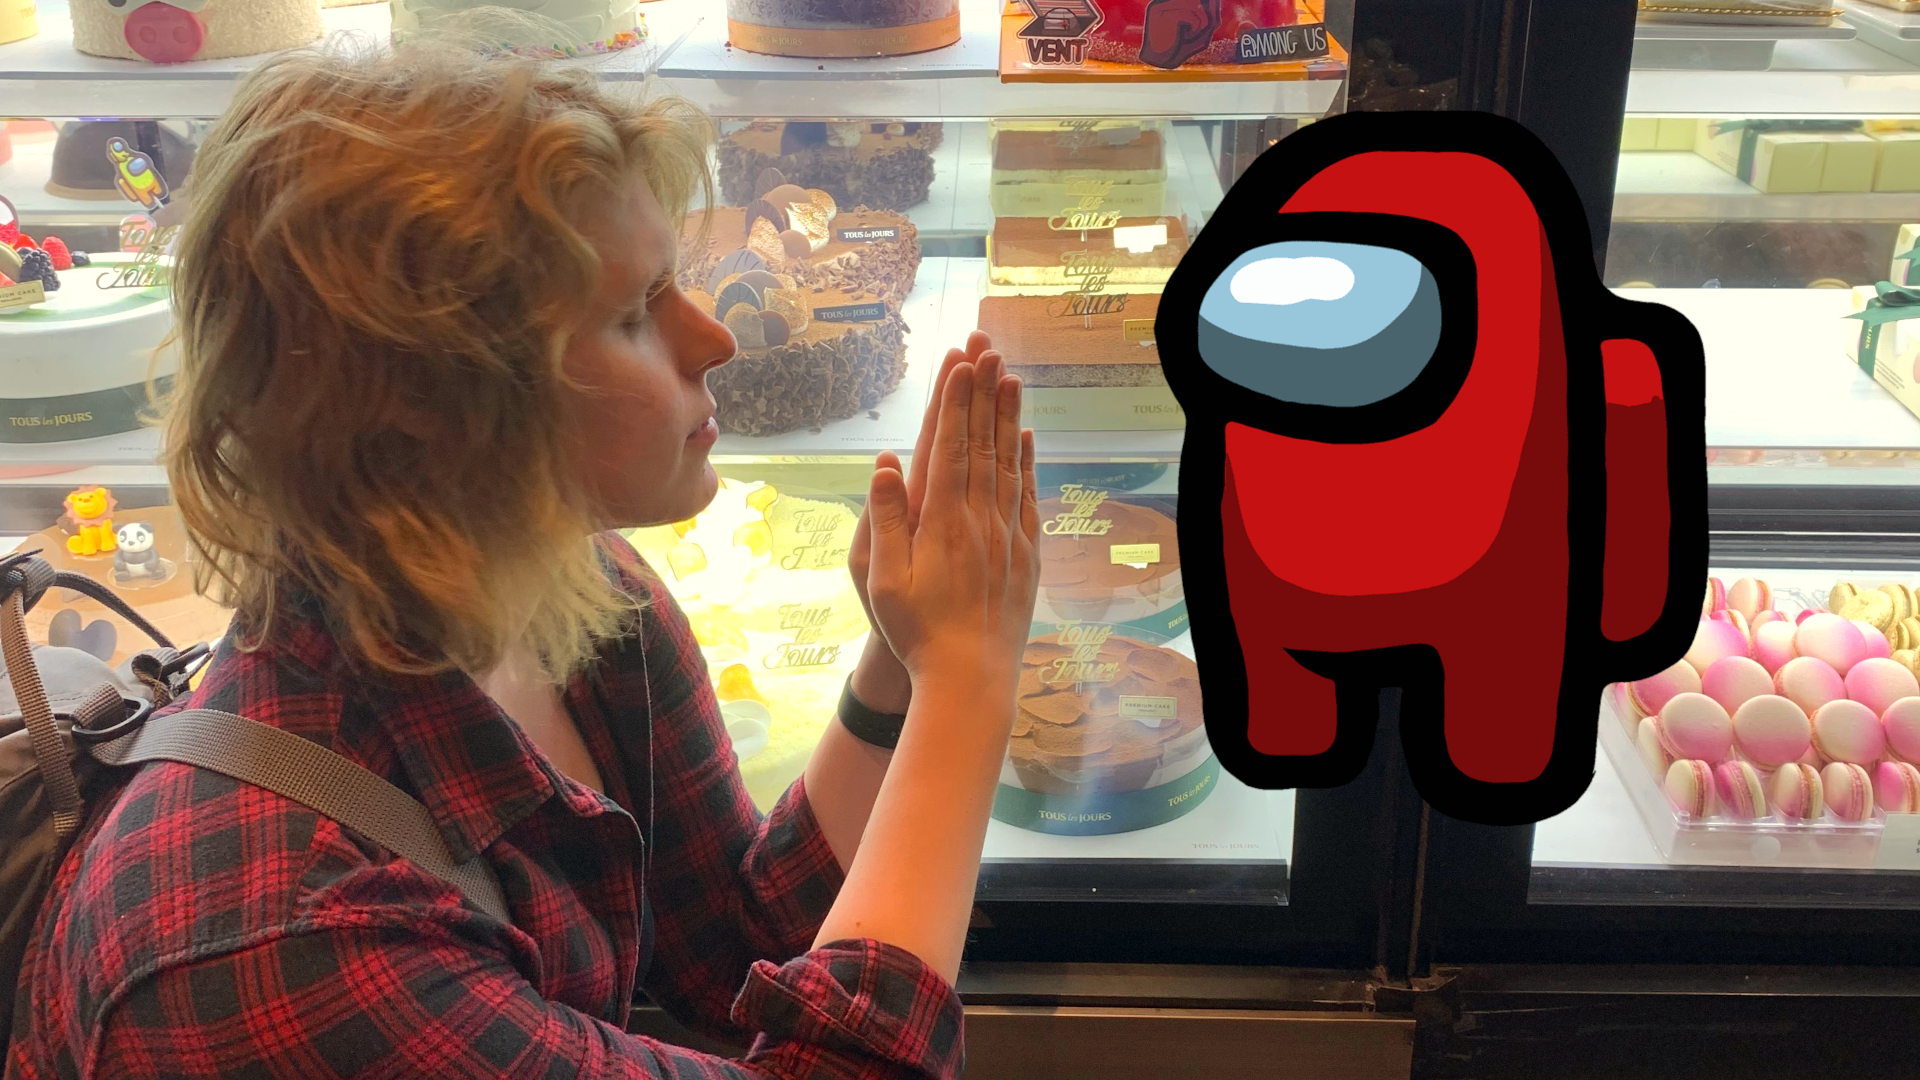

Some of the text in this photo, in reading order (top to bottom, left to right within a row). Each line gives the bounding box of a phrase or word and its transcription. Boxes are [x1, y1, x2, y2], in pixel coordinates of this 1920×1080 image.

[1027, 38, 1089, 64] VENT
[1241, 27, 1327, 58] AMONG US
[843, 231, 864, 239] TOUS
[872, 230, 895, 239] JOURS
[1080, 273, 1110, 292] les
[821, 311, 844, 320] TOUS
[853, 307, 879, 317] JOURS
[1046, 290, 1131, 318] Jours
[1033, 405, 1067, 415] JOURS
[1133, 405, 1162, 413] TOUS
[9, 412, 93, 427] TOUS les JOURS
[1060, 484, 1108, 504] Tous
[1073, 502, 1098, 517] les
[793, 508, 843, 534] Tous
[1043, 512, 1113, 535] Jours
[778, 603, 834, 631] Tous
[793, 627, 823, 645] les
[1056, 618, 1113, 646] Tous
[762, 642, 842, 669] Jours
[1072, 642, 1102, 662] les
[1038, 658, 1121, 683] Jours
[1168, 792, 1189, 807] TOUS
[1194, 775, 1211, 794] JOURS
[1038, 810, 1112, 823] TOUS les JOURS
